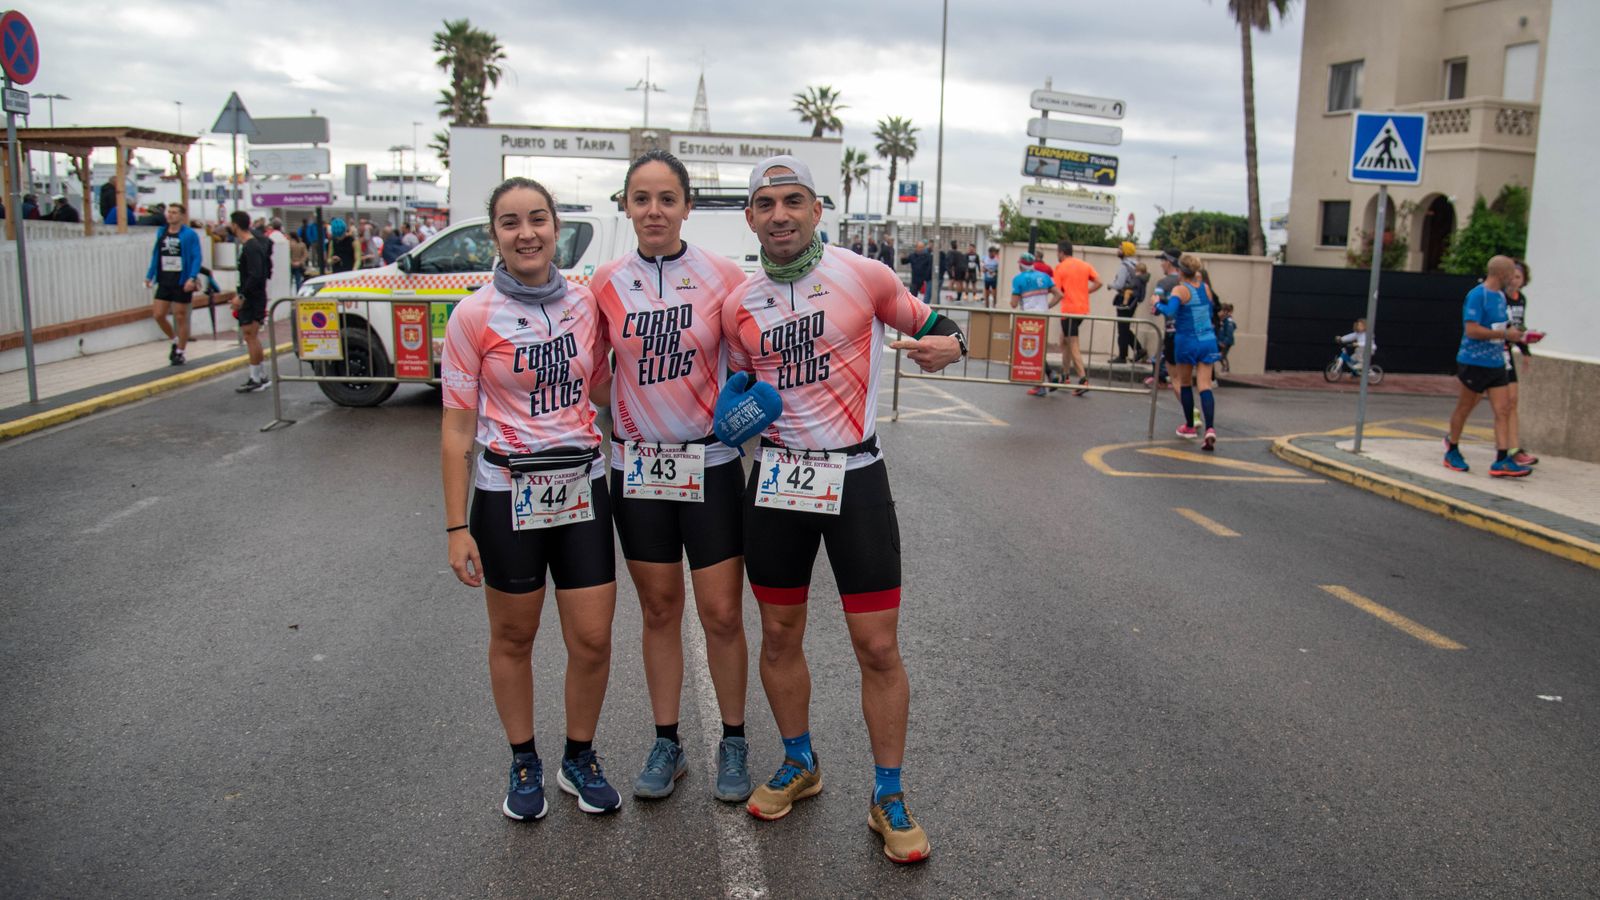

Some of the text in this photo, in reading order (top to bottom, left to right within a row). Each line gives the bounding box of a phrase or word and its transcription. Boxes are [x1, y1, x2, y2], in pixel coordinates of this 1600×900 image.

[501, 133, 615, 151] PUERTO DE TARIFA
[679, 140, 793, 157] ESTACIÓN MARÍTIMA
[1028, 148, 1089, 162] TURMARES
[1090, 156, 1116, 166] Tickets
[904, 184, 912, 195] P
[622, 303, 692, 339] CORRO
[761, 311, 824, 356] CORRO
[514, 333, 577, 373] CORRO
[642, 330, 681, 359] POR
[783, 340, 814, 366] POR
[535, 360, 569, 390] POR
[638, 349, 696, 386] ELLOS
[778, 353, 830, 391] ELLOS
[530, 378, 582, 417] ELLOS
[637, 446, 660, 458] XIV
[777, 452, 802, 465] XIV
[527, 474, 553, 486] XIV
[650, 459, 677, 480] 43
[786, 466, 815, 491] 42
[540, 484, 567, 508] 44
